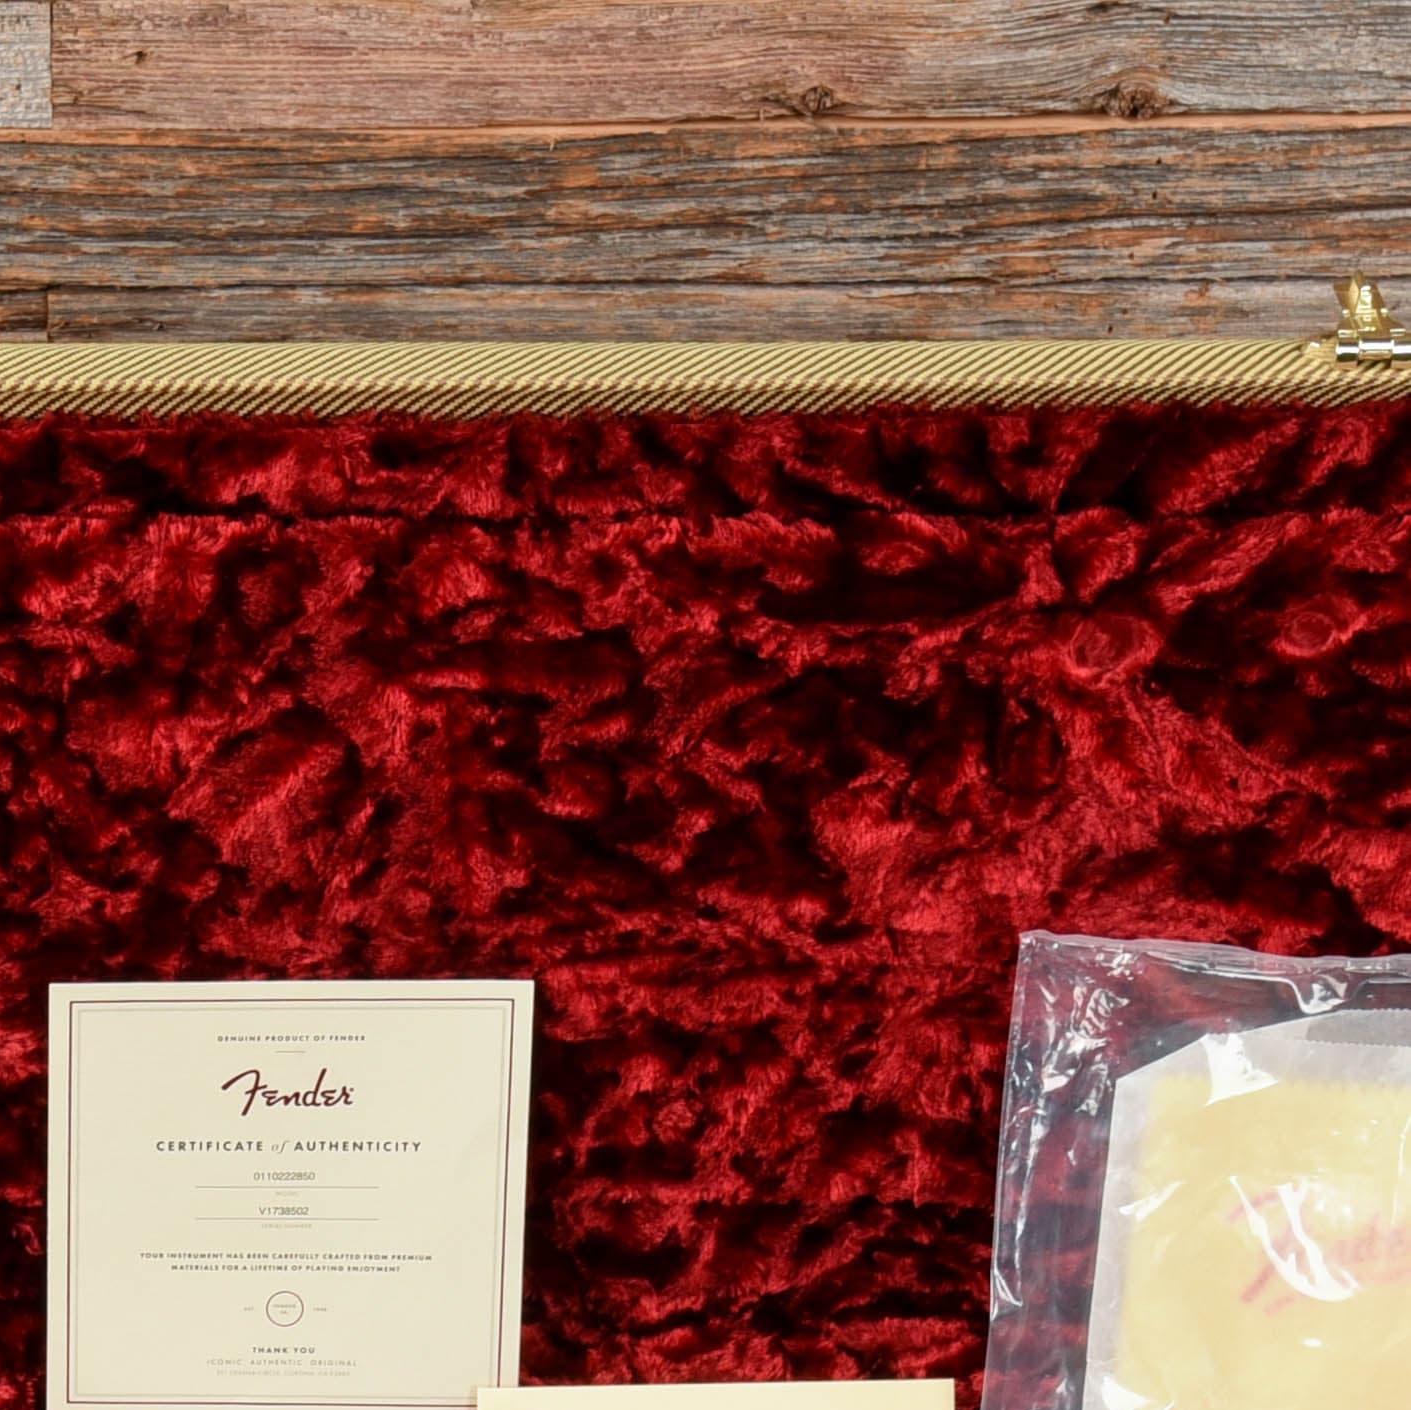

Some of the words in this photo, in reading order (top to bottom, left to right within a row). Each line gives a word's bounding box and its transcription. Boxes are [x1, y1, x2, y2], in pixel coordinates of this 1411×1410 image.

[221, 1068, 354, 1116] Fender
[156, 1140, 264, 1152] CERTIFICATE
[271, 1140, 290, 1154] of
[293, 1140, 422, 1152] AUTHENTICITY
[253, 1172, 316, 1181] 0110222850
[140, 1252, 164, 1260] YOUR
[166, 1252, 224, 1260] INSTRUMENT
[226, 1252, 244, 1260] HAS
[252, 1346, 288, 1354] THANK
[293, 1346, 316, 1354] YOU
